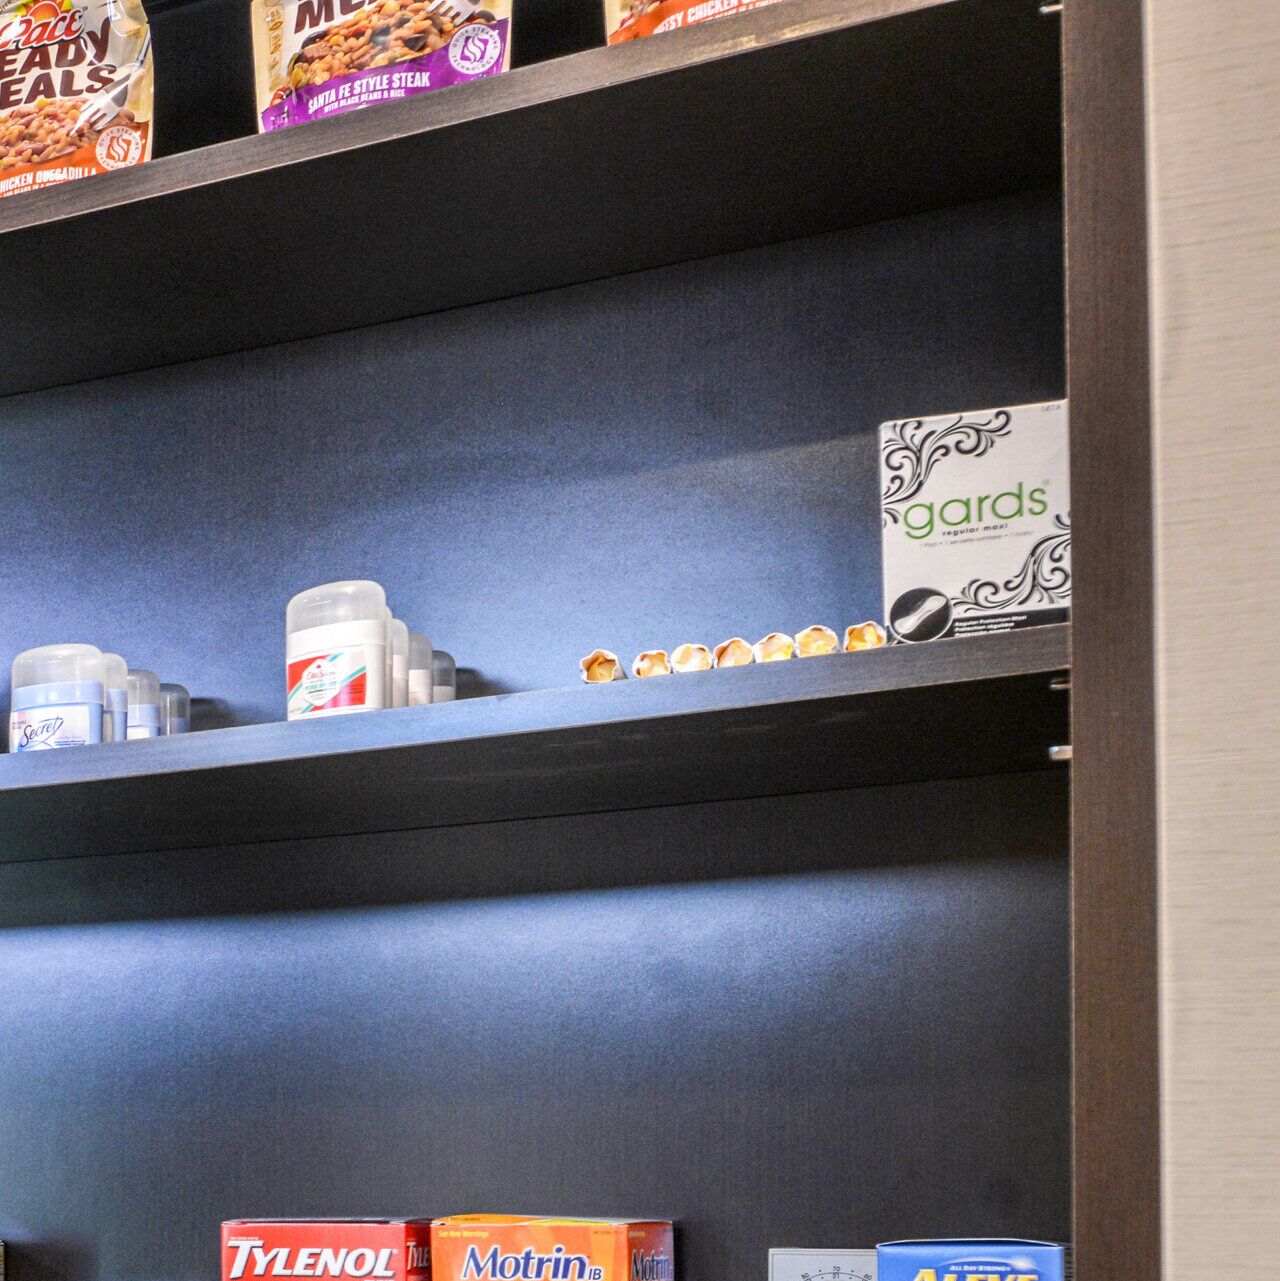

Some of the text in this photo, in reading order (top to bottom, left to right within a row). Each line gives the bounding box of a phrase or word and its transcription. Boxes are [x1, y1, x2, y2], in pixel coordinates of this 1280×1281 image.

[308, 72, 430, 114] SANTA FE STYLE STEAK
[904, 482, 1048, 540] gards
[942, 523, 1008, 536] regular maxi
[20, 716, 64, 747] Secret
[227, 1240, 396, 1279] TYLENOL
[406, 1241, 429, 1271] TYLE
[462, 1246, 601, 1280] Motrin IB
